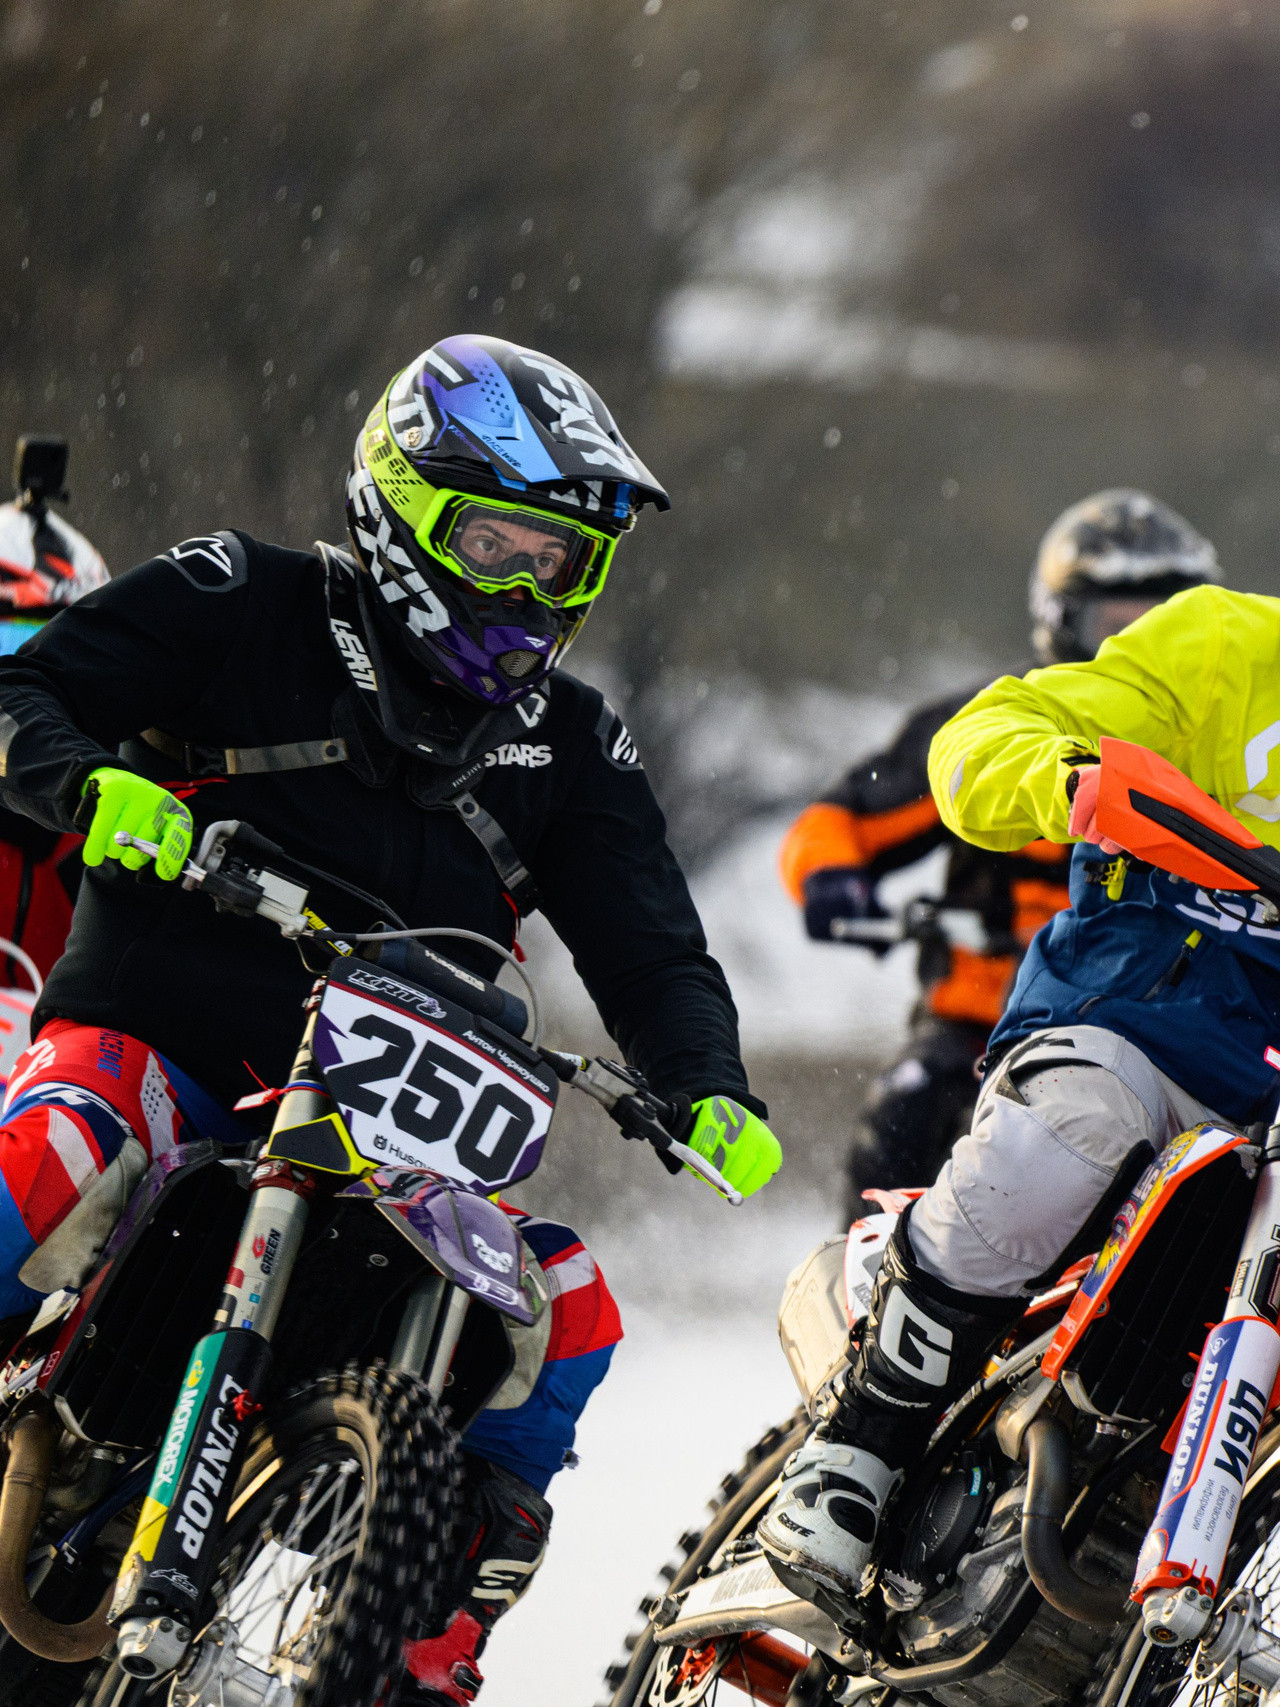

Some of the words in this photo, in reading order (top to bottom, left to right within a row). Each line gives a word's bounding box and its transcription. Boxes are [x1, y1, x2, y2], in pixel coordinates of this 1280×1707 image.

[322, 1013, 536, 1184] 250
[461, 1029, 496, 1054] Антон
[497, 1049, 551, 1094] Черноушко
[260, 1227, 282, 1275] GREEN
[156, 1388, 199, 1490] MOTOREX
[174, 1373, 245, 1560] DUNLOP
[1171, 1359, 1219, 1488] DUNLOP
[1213, 1378, 1268, 1487] ЦБИ
[1191, 1478, 1216, 1532] информации
[1204, 1485, 1229, 1543] безопасности
